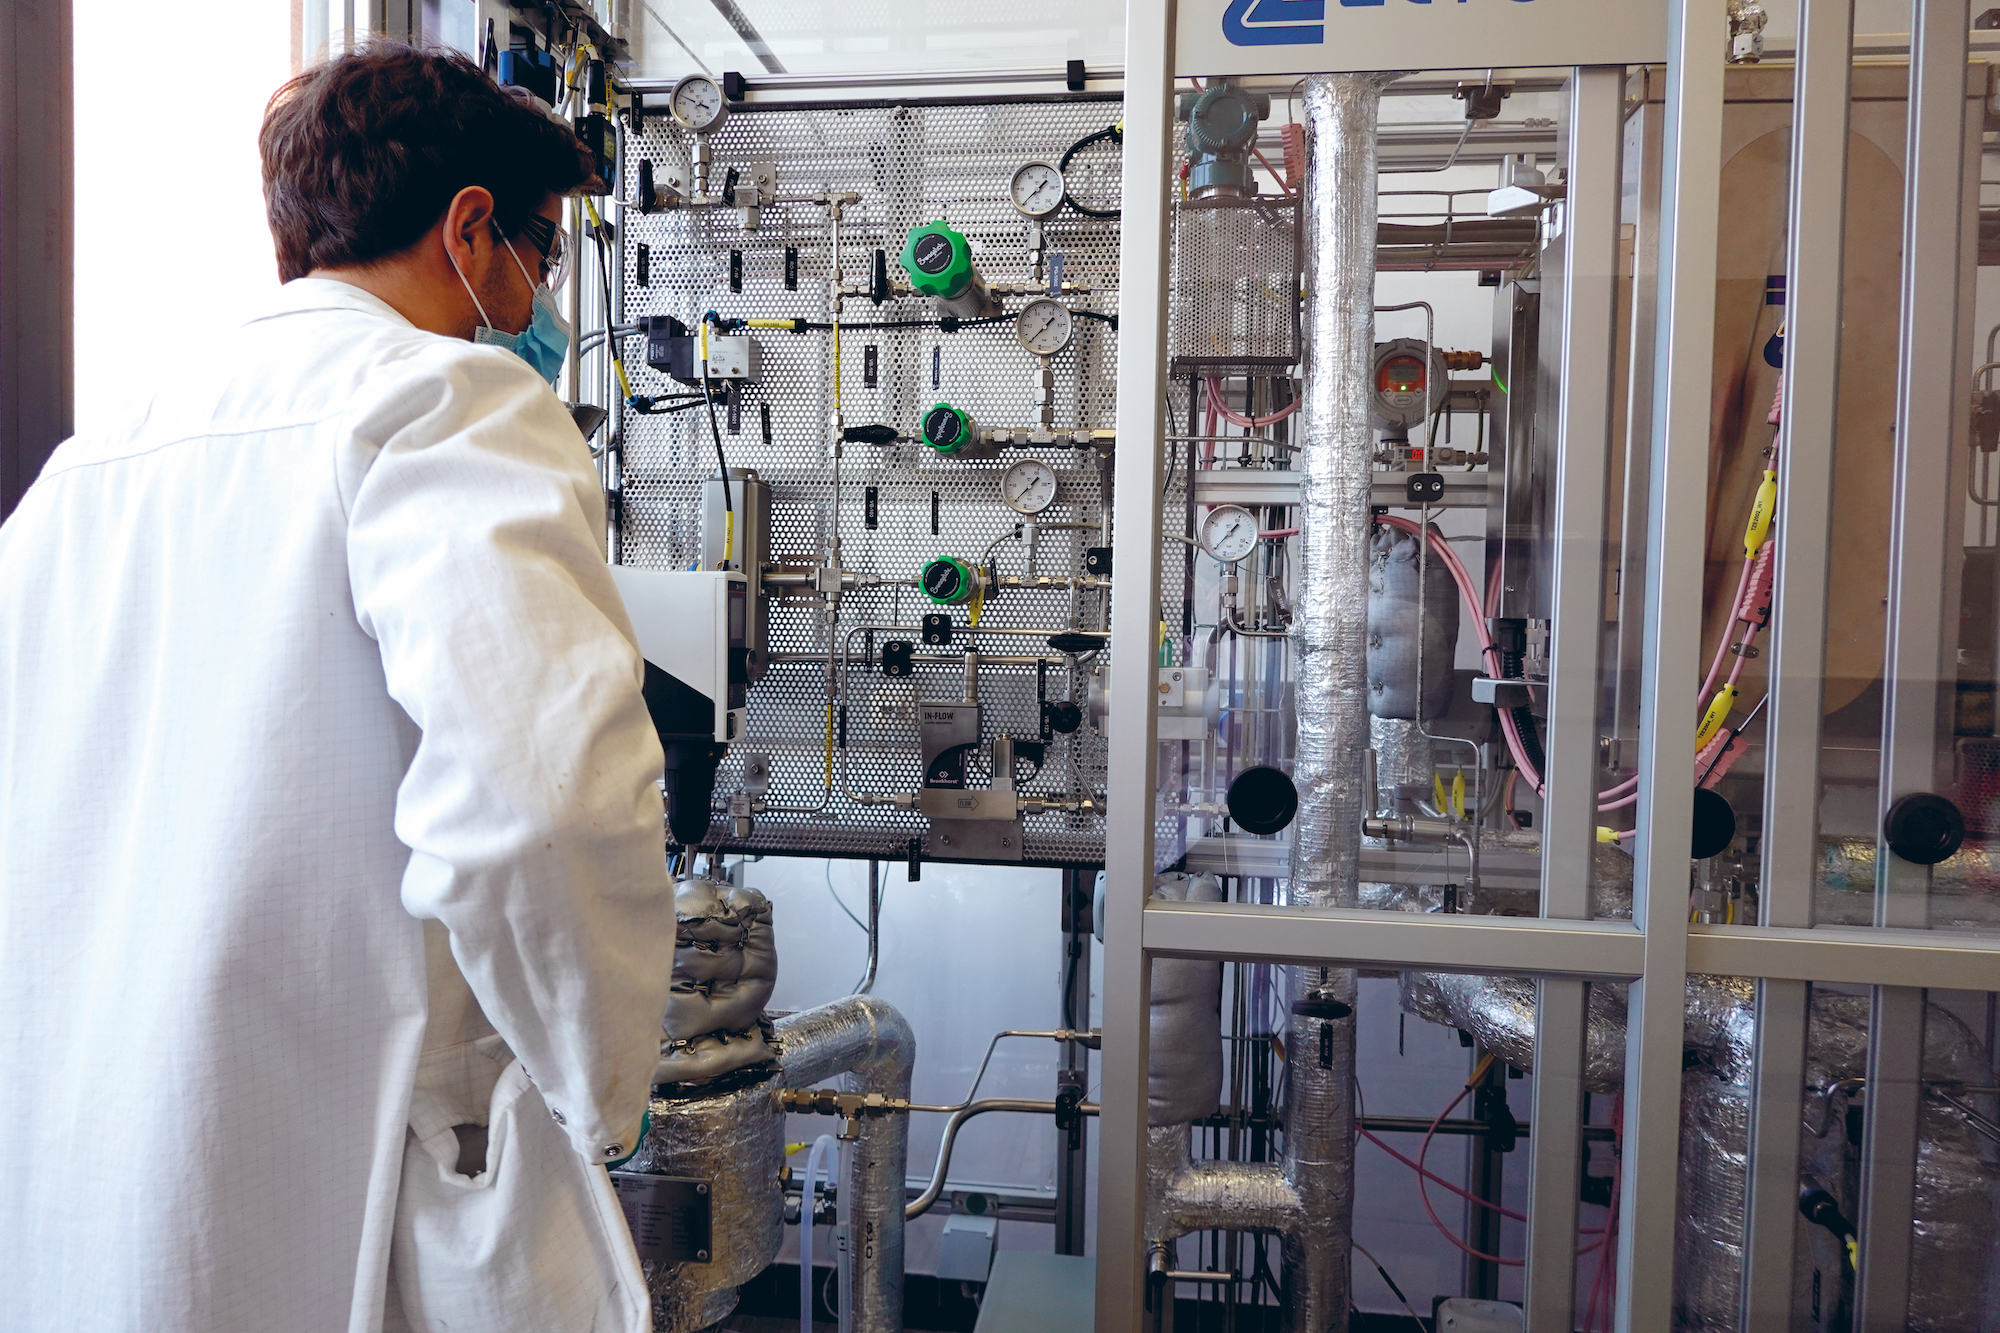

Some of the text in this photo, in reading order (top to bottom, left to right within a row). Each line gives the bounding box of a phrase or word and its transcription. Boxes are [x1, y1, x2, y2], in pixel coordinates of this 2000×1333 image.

[916, 242, 947, 266] Swagelok
[929, 567, 954, 595] Swagelok
[924, 711, 954, 720] IN-FLOW
